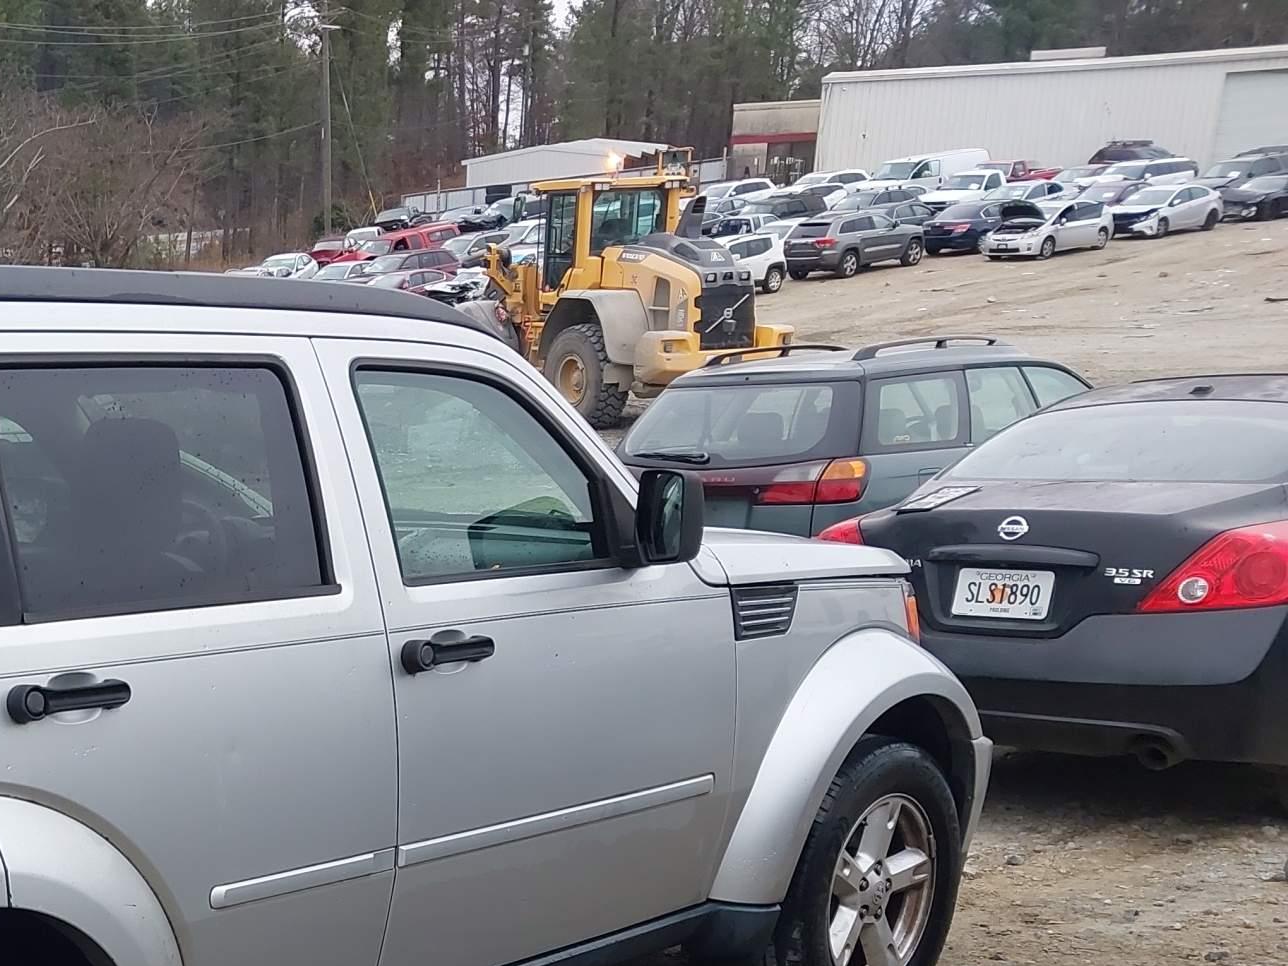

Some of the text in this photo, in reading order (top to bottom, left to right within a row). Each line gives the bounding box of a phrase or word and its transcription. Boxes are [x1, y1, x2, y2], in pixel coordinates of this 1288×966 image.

[979, 572, 1031, 582] GEORGIA
[1130, 568, 1154, 579] SR
[964, 581, 1041, 606] SLS1890
